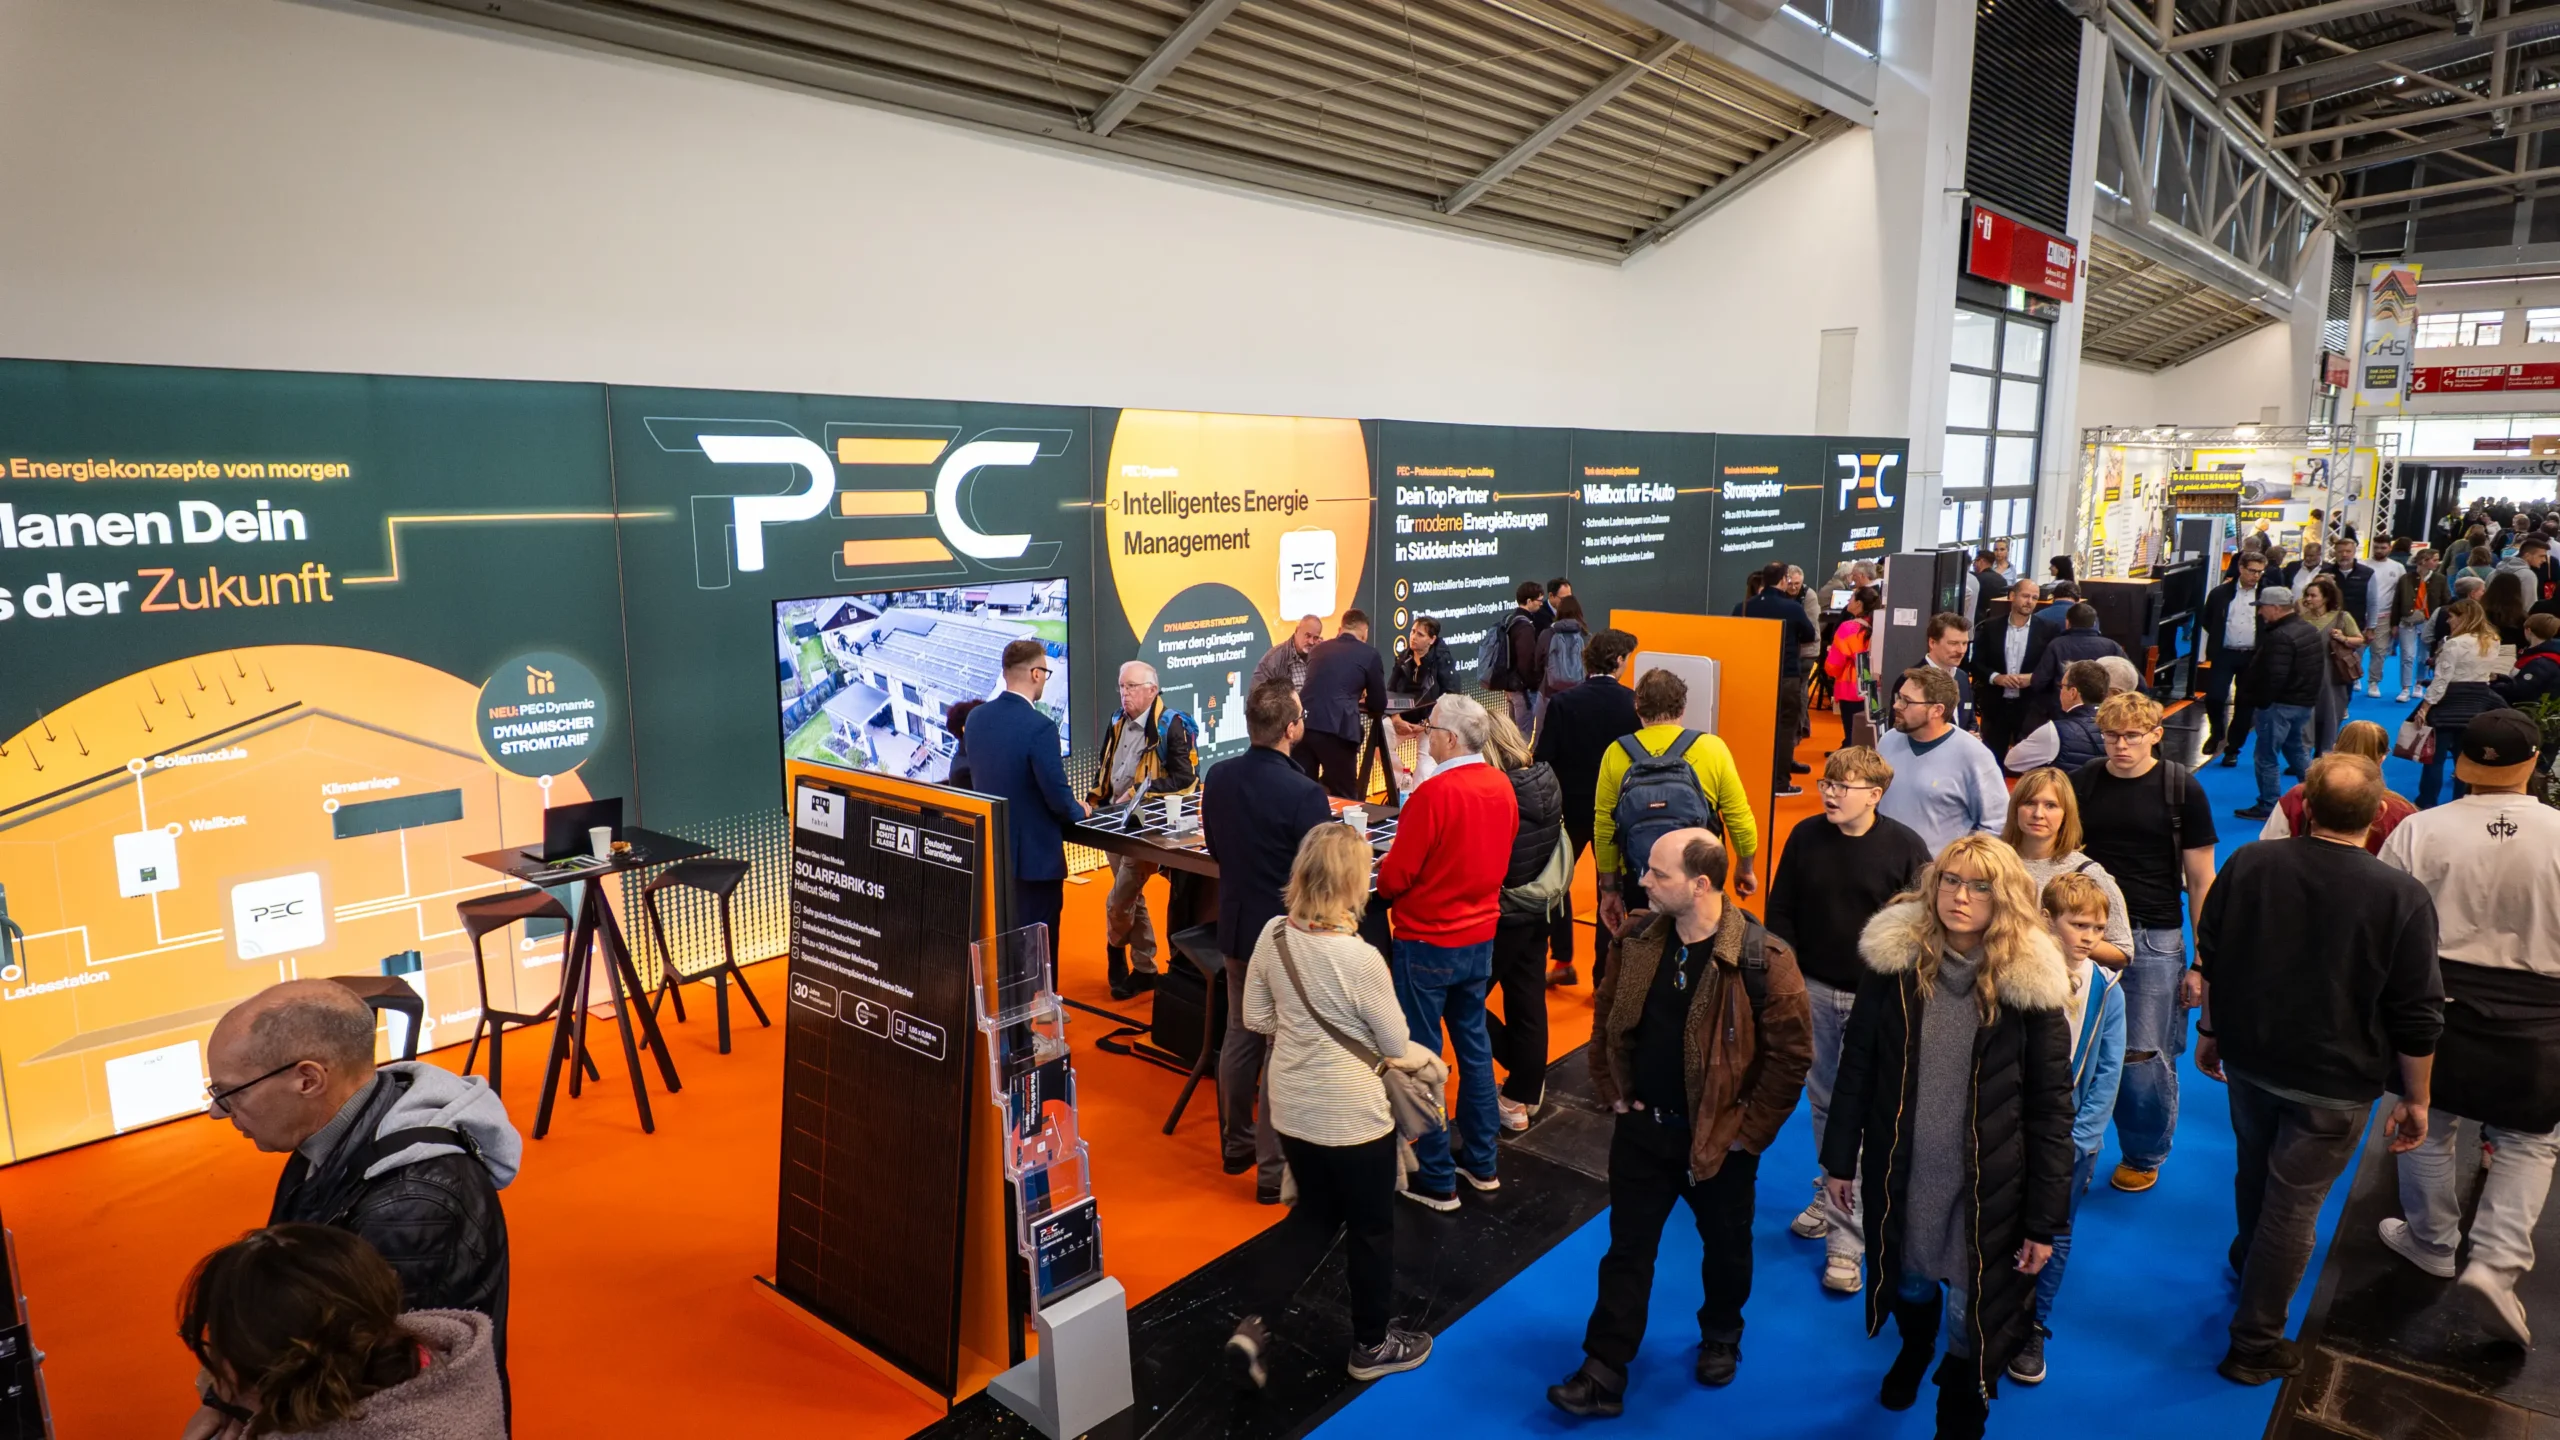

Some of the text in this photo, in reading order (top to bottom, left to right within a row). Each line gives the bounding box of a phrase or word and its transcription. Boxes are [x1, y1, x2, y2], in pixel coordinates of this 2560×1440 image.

[10, 458, 220, 482] Energiekonzepte
[223, 462, 264, 479] von
[268, 461, 350, 482] morgen
[1396, 466, 1410, 476] PEC
[1414, 466, 1448, 476] Professional
[1448, 466, 1466, 478] Energy
[1584, 482, 1675, 504] Wallbox für E-Auto
[1723, 480, 1782, 502] Stromspeicher
[1838, 454, 1899, 511] PEC
[697, 435, 1040, 572] PEC
[1124, 489, 1309, 519] Intelligentes Energie
[1396, 486, 1489, 508] Dein Top Partner
[0, 499, 308, 548] lanen Dein
[1396, 511, 1548, 533] für moderne Energielösungen
[1124, 528, 1250, 557] Management
[1396, 537, 1498, 562] in Süddeutschland
[1291, 562, 1325, 582] PEC
[22, 572, 130, 618] der
[137, 562, 333, 612] Zukunft
[1412, 576, 1510, 593] 7.000 installierte Energiesysteme
[1468, 604, 1477, 615] bei
[1478, 602, 1498, 614] Google
[1158, 630, 1254, 653] Immer den günstigsten
[1166, 646, 1246, 669] Strompreis nutzen!
[489, 698, 595, 720] NEU: PEC Dynamic
[493, 716, 594, 739] DYNAMISCHER
[500, 733, 589, 755] STROMTARIF
[154, 746, 248, 769] Solarmodule
[322, 776, 400, 796] Klimaanlage
[189, 815, 247, 832] Wallbox
[879, 822, 896, 833] BRAND
[876, 830, 896, 840] SCHUTZ
[876, 837, 896, 849] KLASSE
[901, 832, 911, 850] A
[924, 837, 952, 852] Deutscher
[924, 846, 963, 864] Garantiegeber
[794, 878, 840, 903] Halfcut Series
[795, 860, 885, 900] SOLARFABRIK 315
[250, 899, 304, 923] PEC
[4, 969, 110, 1001] Ladesstation
[794, 982, 808, 999] 30
[1040, 1222, 1058, 1238] PEC
